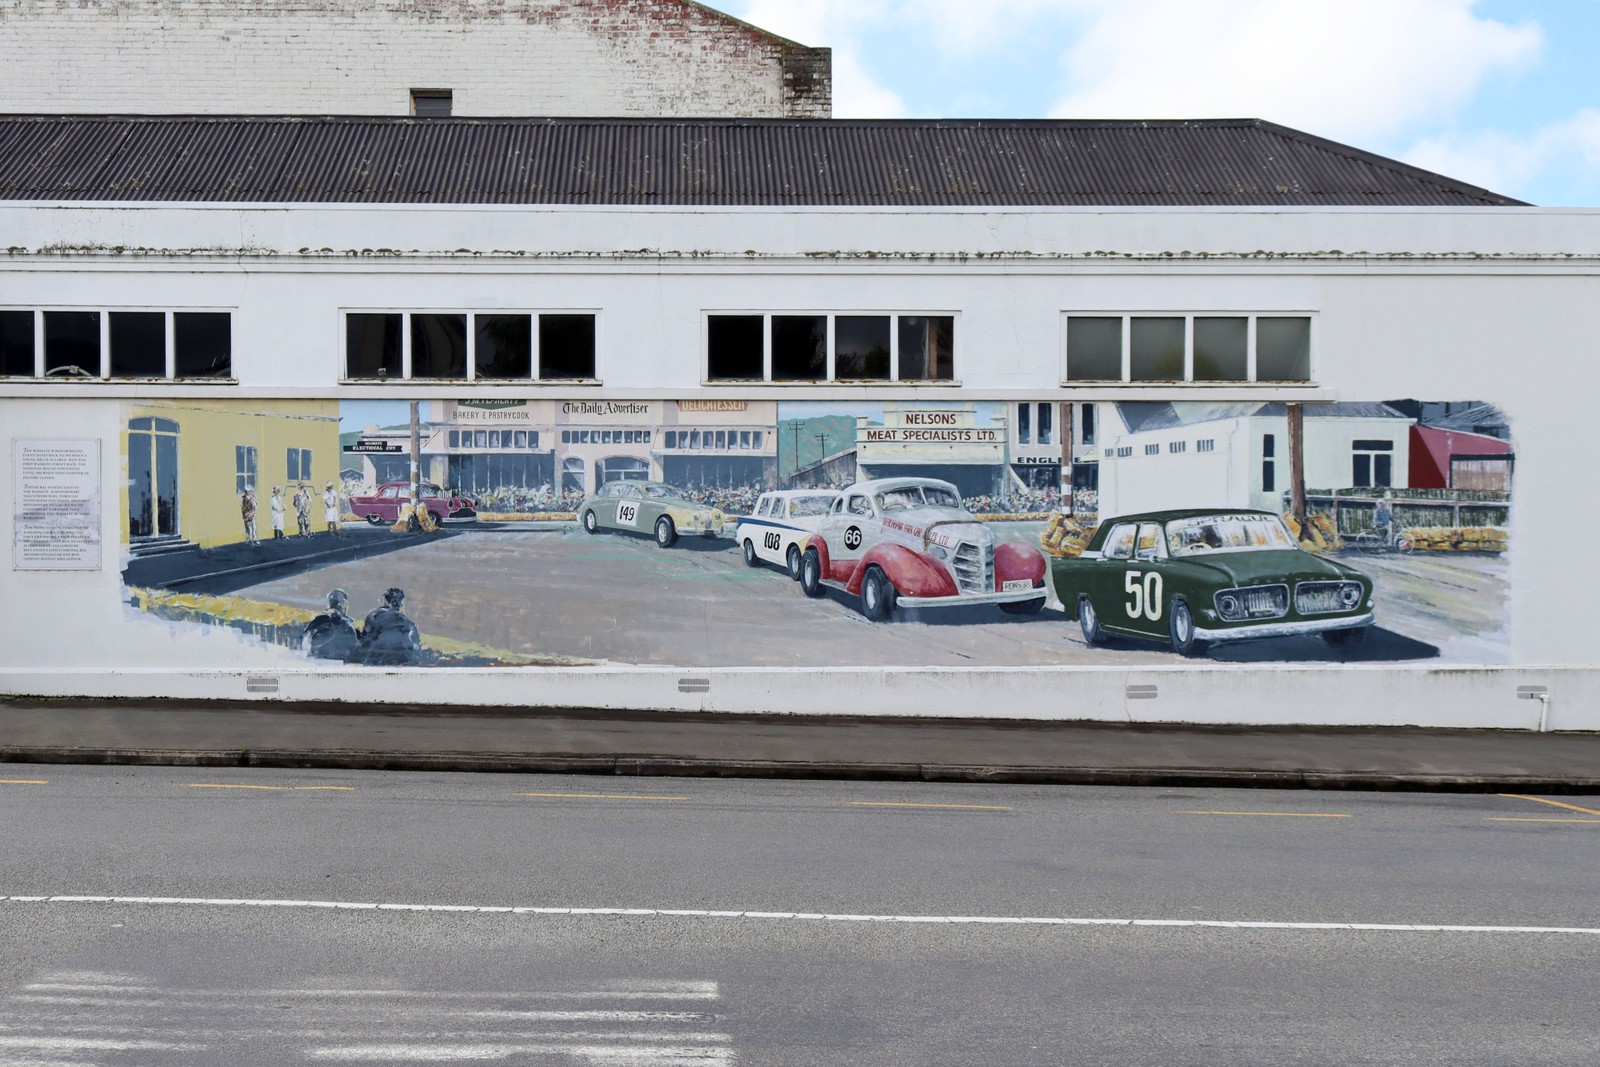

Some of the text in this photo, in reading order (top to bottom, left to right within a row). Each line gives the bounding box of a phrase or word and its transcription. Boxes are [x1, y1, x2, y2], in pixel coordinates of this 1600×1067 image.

[453, 411, 479, 419] BAKERY
[562, 402, 649, 416] The Daily Advertiser
[905, 413, 957, 425] NELSONS
[867, 430, 997, 441] MEAT SPECIALISTS LTD.
[619, 505, 635, 521] 149
[764, 531, 780, 550] 108
[845, 529, 862, 545] 66
[1125, 570, 1163, 621] 50
